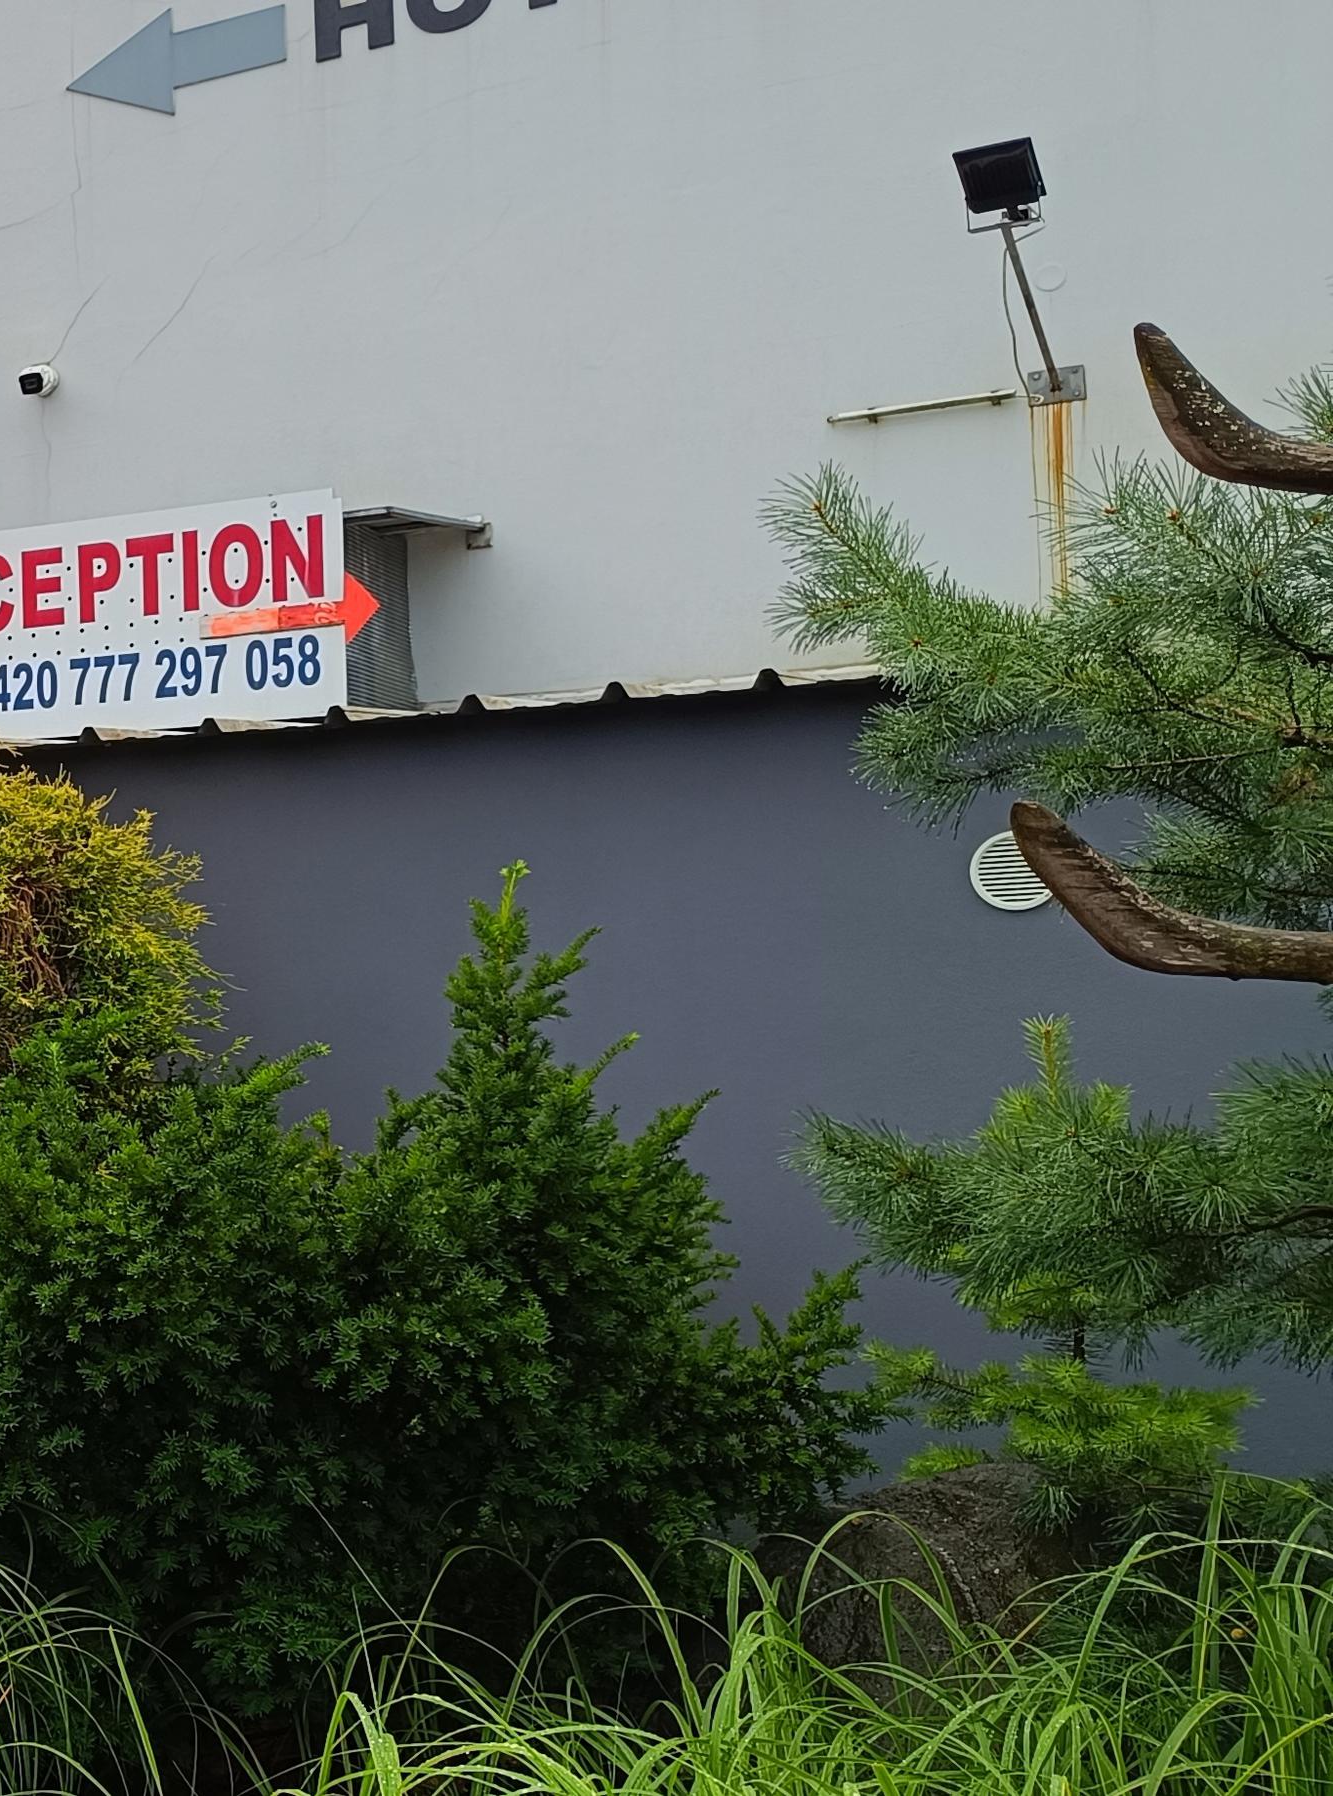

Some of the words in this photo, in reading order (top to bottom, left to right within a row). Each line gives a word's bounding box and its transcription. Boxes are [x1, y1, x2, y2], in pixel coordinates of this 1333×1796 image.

[69, 652, 140, 705] 777
[155, 644, 228, 698] 297
[246, 634, 321, 690] 058
